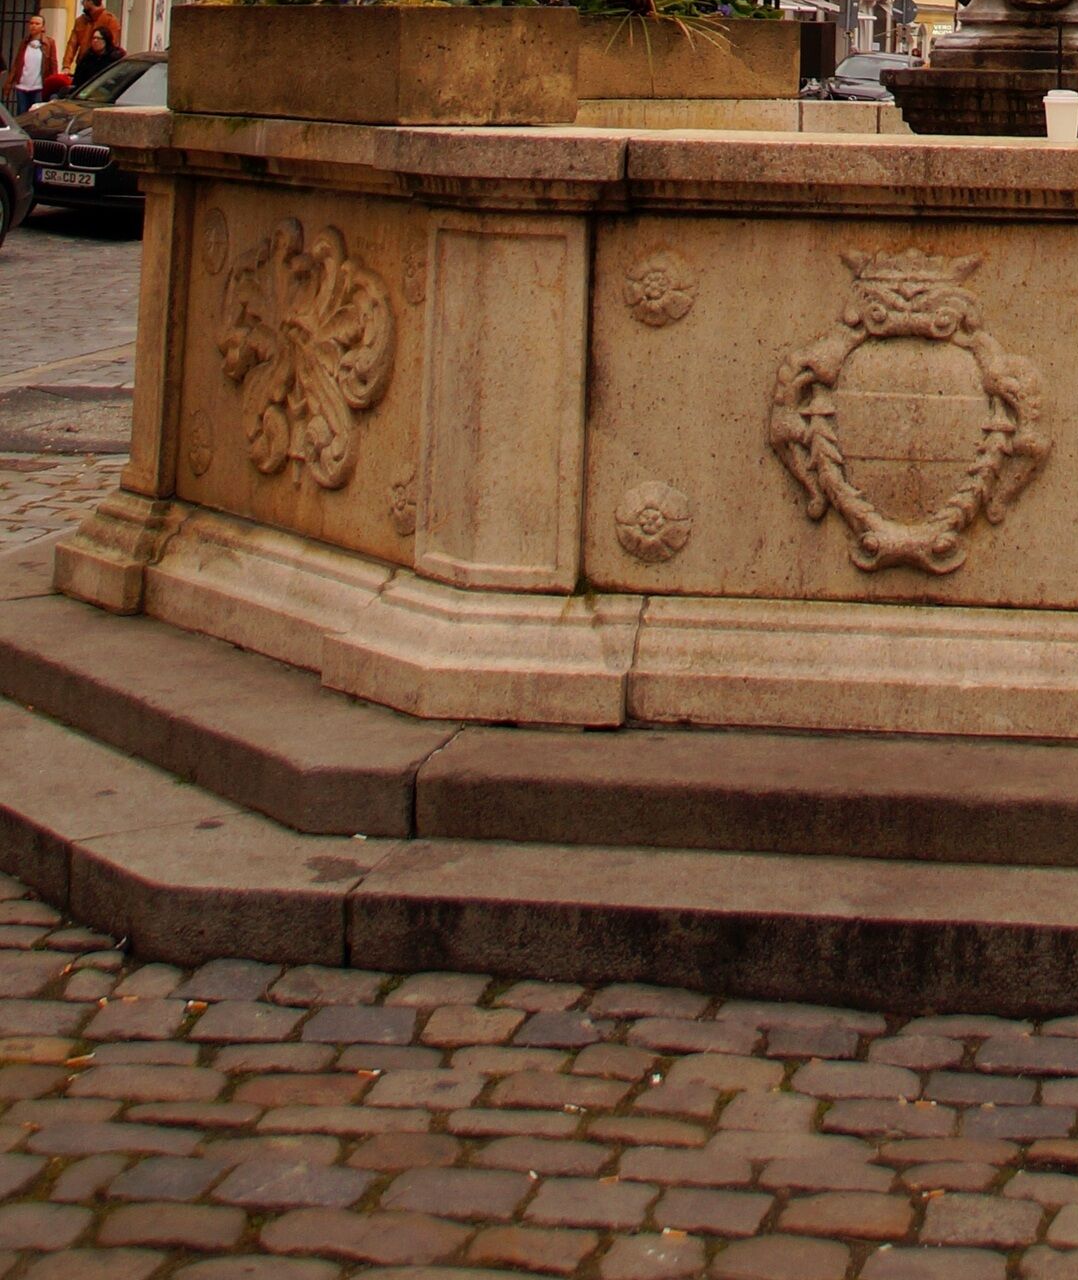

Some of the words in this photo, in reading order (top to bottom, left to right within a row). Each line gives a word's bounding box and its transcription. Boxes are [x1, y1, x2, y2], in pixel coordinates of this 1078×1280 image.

[45, 170, 57, 181] SR
[63, 172, 76, 183] CD
[79, 174, 91, 185] 22
